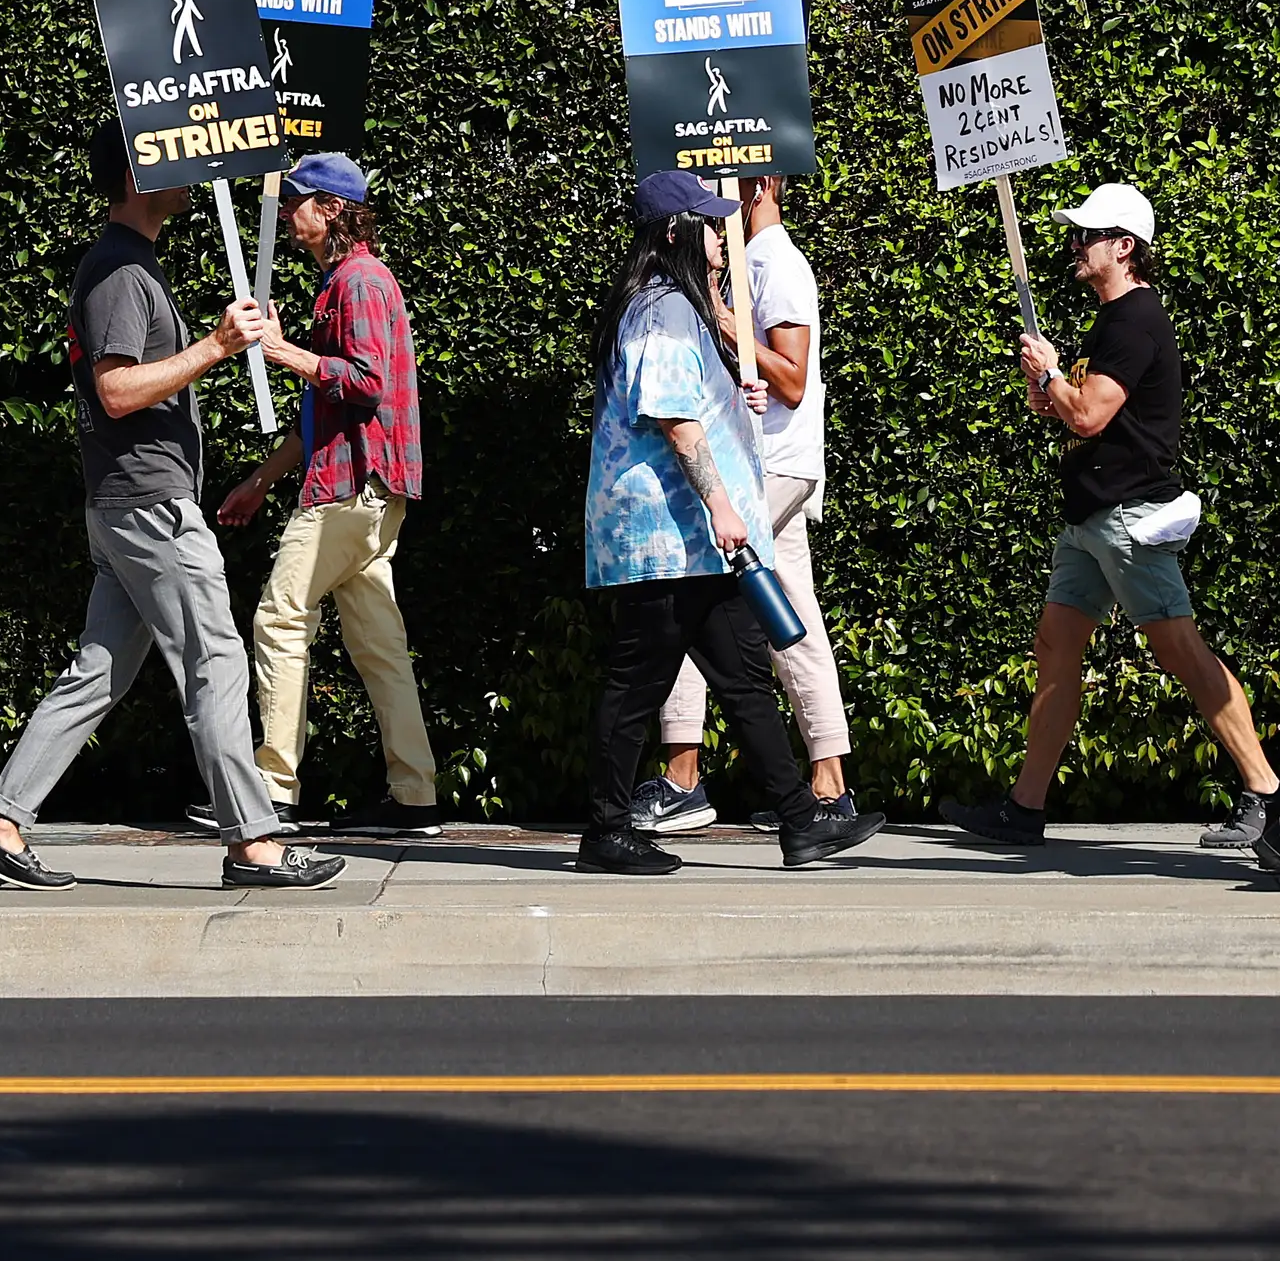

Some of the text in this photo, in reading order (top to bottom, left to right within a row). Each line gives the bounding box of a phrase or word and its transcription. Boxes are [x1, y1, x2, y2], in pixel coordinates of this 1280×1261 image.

[654, 11, 772, 43] STANDS WITH
[921, 21, 953, 65] ON
[938, 82, 966, 108] NO
[188, 101, 219, 122] ON
[958, 111, 972, 136] 2
[133, 114, 280, 166] STRIKE!
[712, 136, 732, 146] ON
[676, 144, 772, 168] STRIKE!
